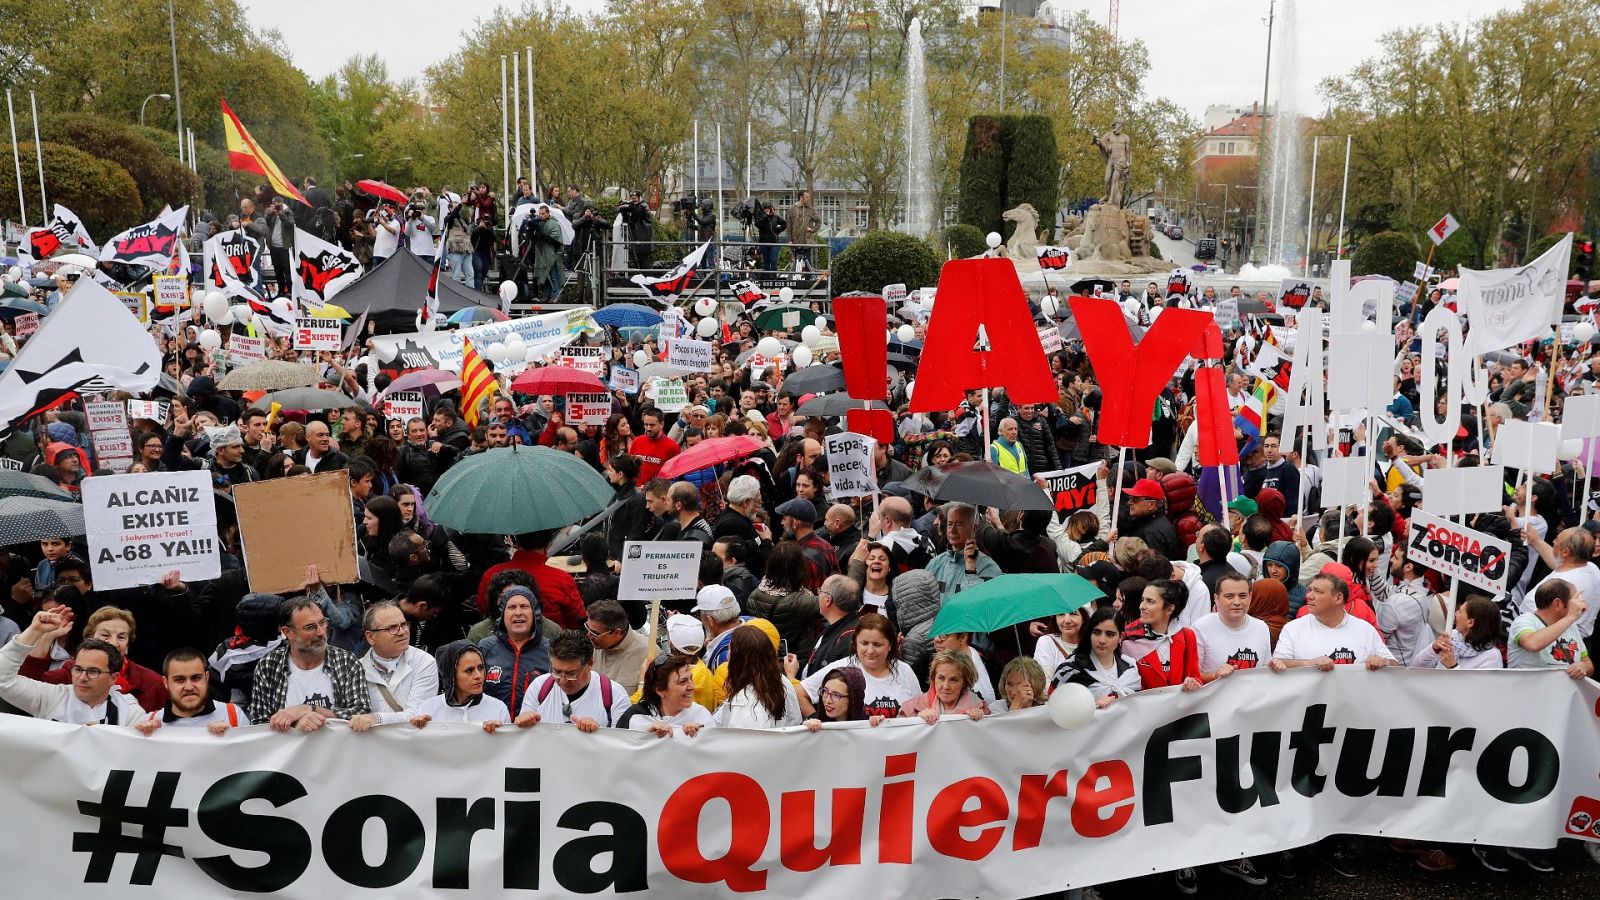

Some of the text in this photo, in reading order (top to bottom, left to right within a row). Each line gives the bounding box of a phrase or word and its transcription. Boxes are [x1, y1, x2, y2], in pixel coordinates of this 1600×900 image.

[295, 318, 340, 329] TERUEL
[509, 319, 544, 332] Solana
[559, 346, 602, 357] TERUEL
[401, 352, 433, 369] SORIA
[567, 393, 611, 403] TERUEL
[834, 477, 855, 491] vida
[107, 485, 200, 508] ALCAÑIZ
[122, 510, 189, 530] EXISTE
[1426, 522, 1482, 557] SORIA
[98, 538, 213, 565] A-68 YA!!!
[645, 552, 695, 560] PERMANECER
[1409, 549, 1502, 591] despoblación
[1237, 652, 1256, 662] SORIA
[1334, 651, 1352, 660] SORIA
[875, 700, 896, 708] SORIA
[72, 703, 1561, 893] #SoriaQuiereFuturo
